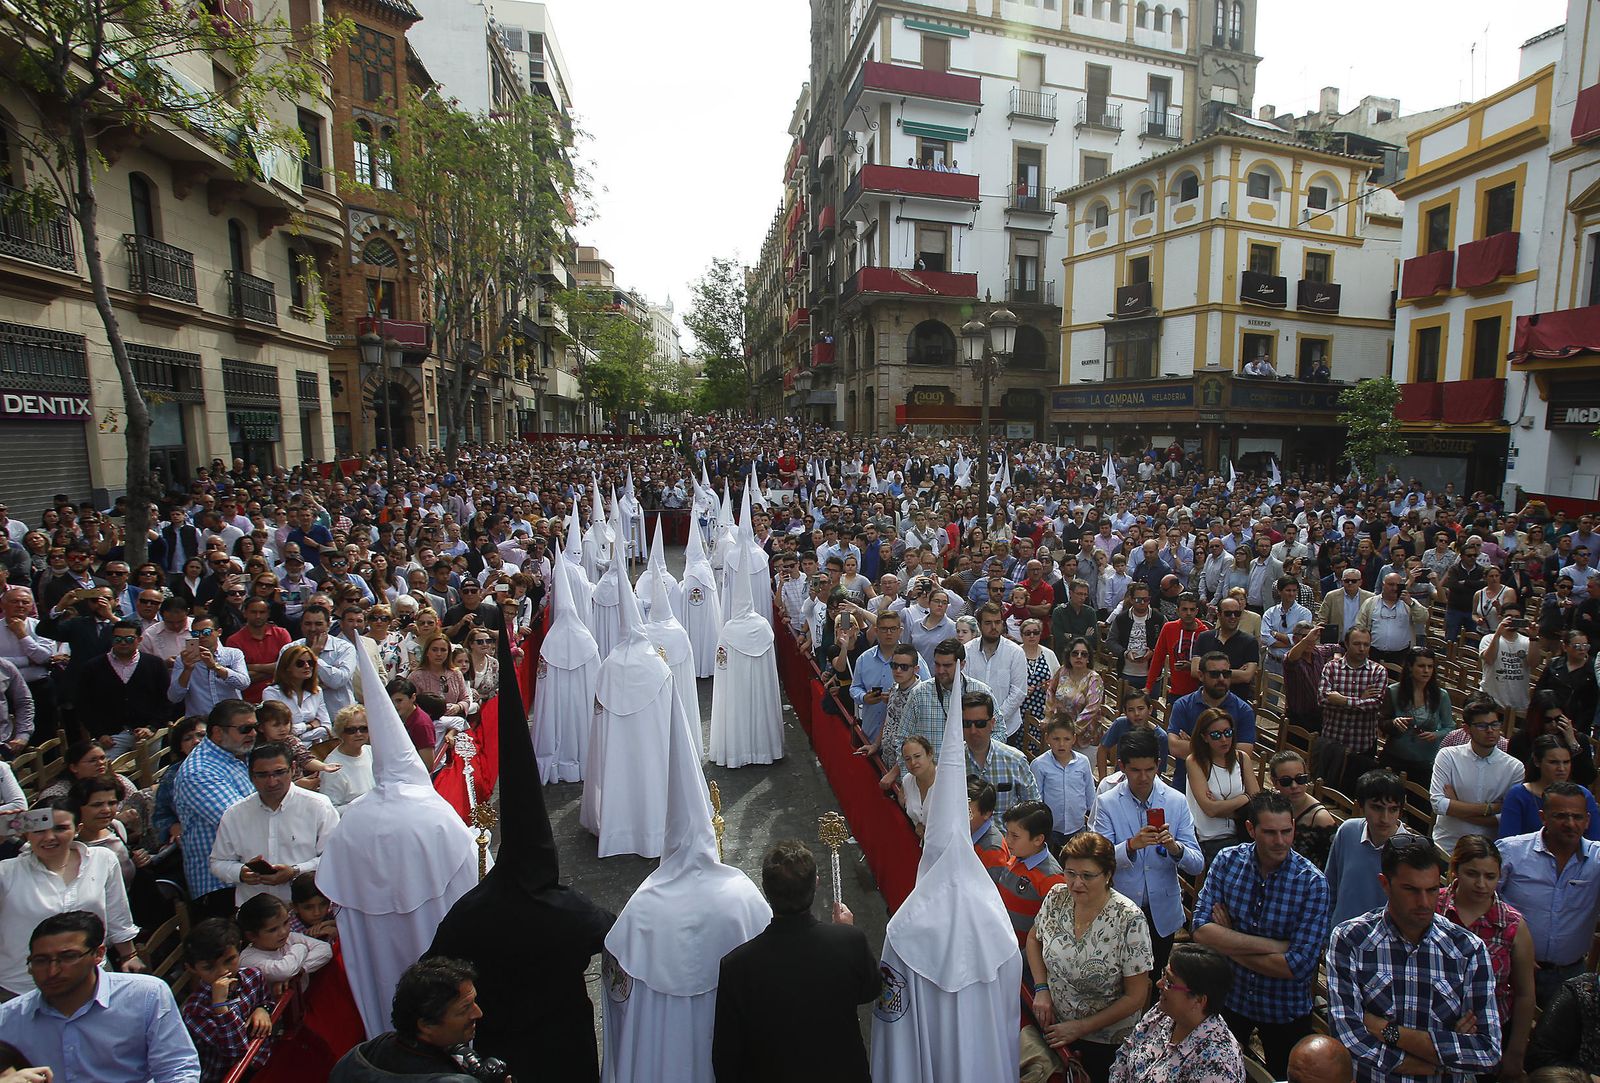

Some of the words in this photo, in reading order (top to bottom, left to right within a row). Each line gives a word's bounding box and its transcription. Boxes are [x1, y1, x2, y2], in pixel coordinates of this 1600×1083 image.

[1090, 394, 1101, 405] LA
[1104, 393, 1145, 405] CAMPANA
[1151, 392, 1187, 401] HELADERIA
[3, 394, 92, 416] DENTIX
[1433, 439, 1471, 451] COFFEE
